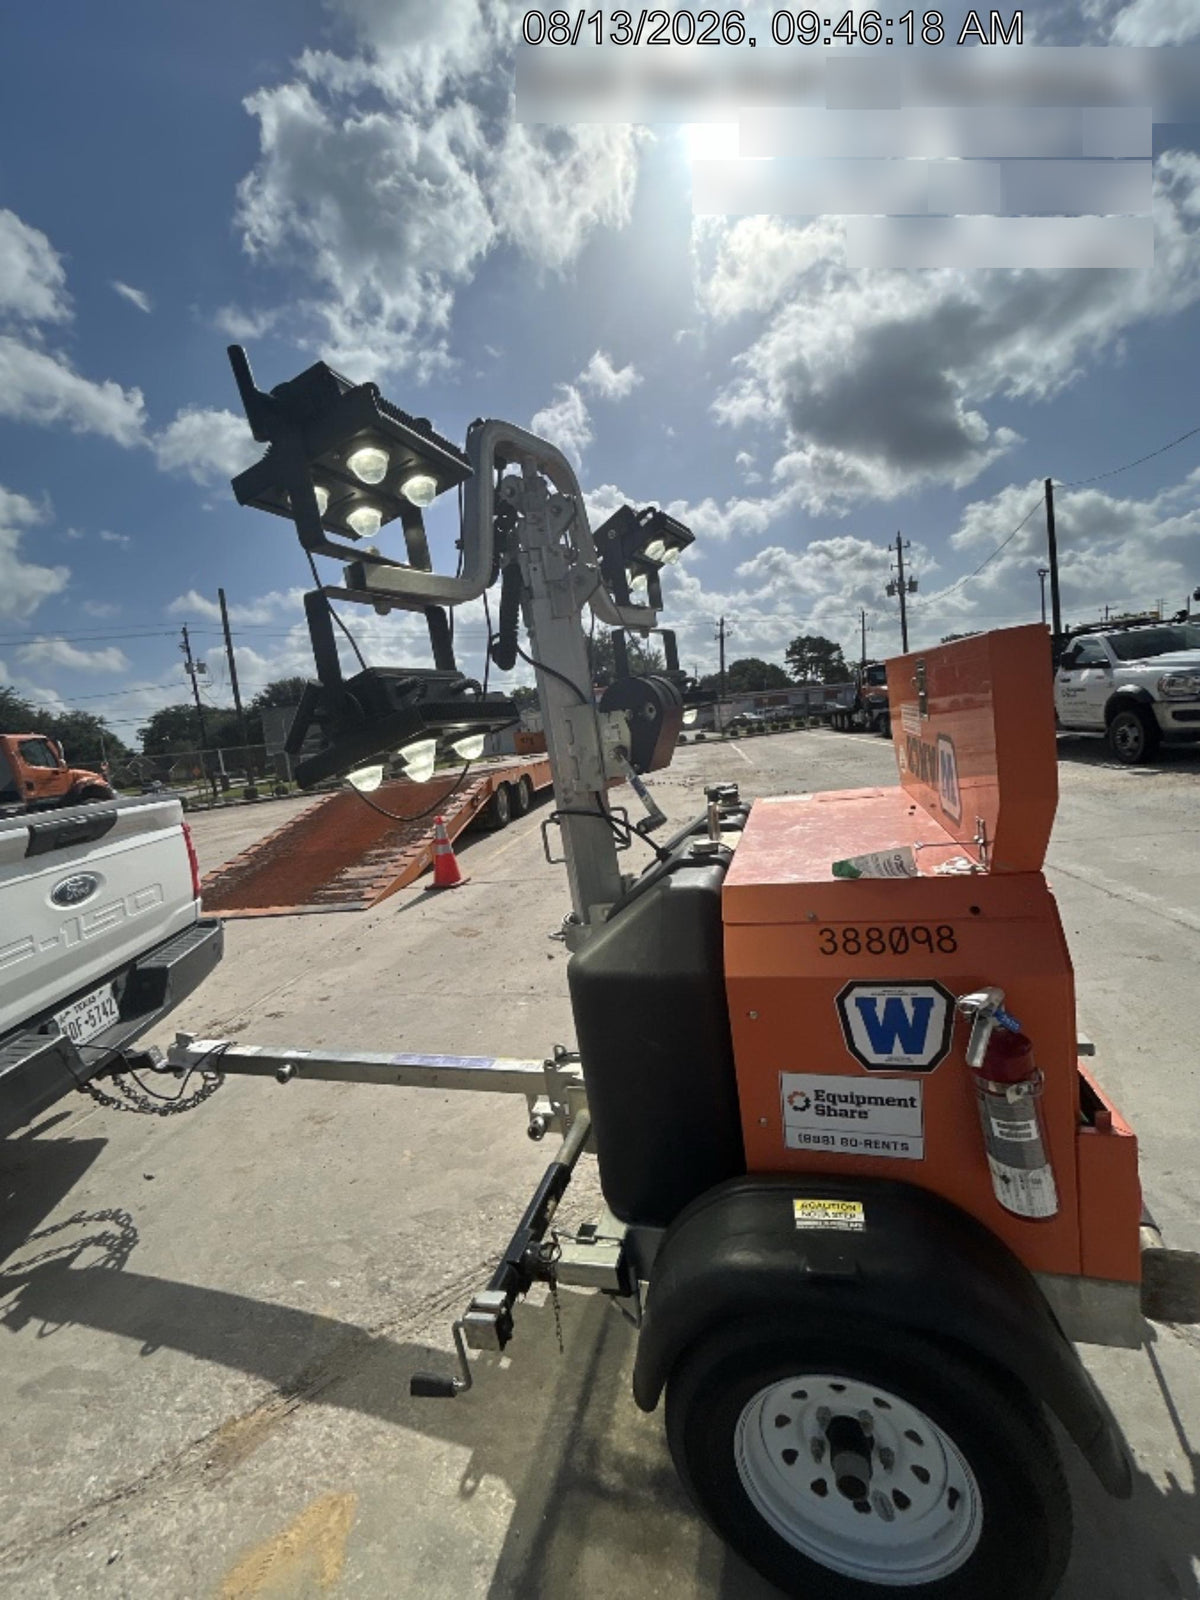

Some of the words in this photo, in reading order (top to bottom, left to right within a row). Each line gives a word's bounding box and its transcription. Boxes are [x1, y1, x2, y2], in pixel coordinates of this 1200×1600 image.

[819, 924, 957, 955] 388098
[855, 997, 934, 1055] W
[814, 1089, 918, 1109] Equipment
[814, 1103, 869, 1119] Share
[798, 1132, 835, 1146] (888)
[808, 1201, 856, 1212] CAUTION
